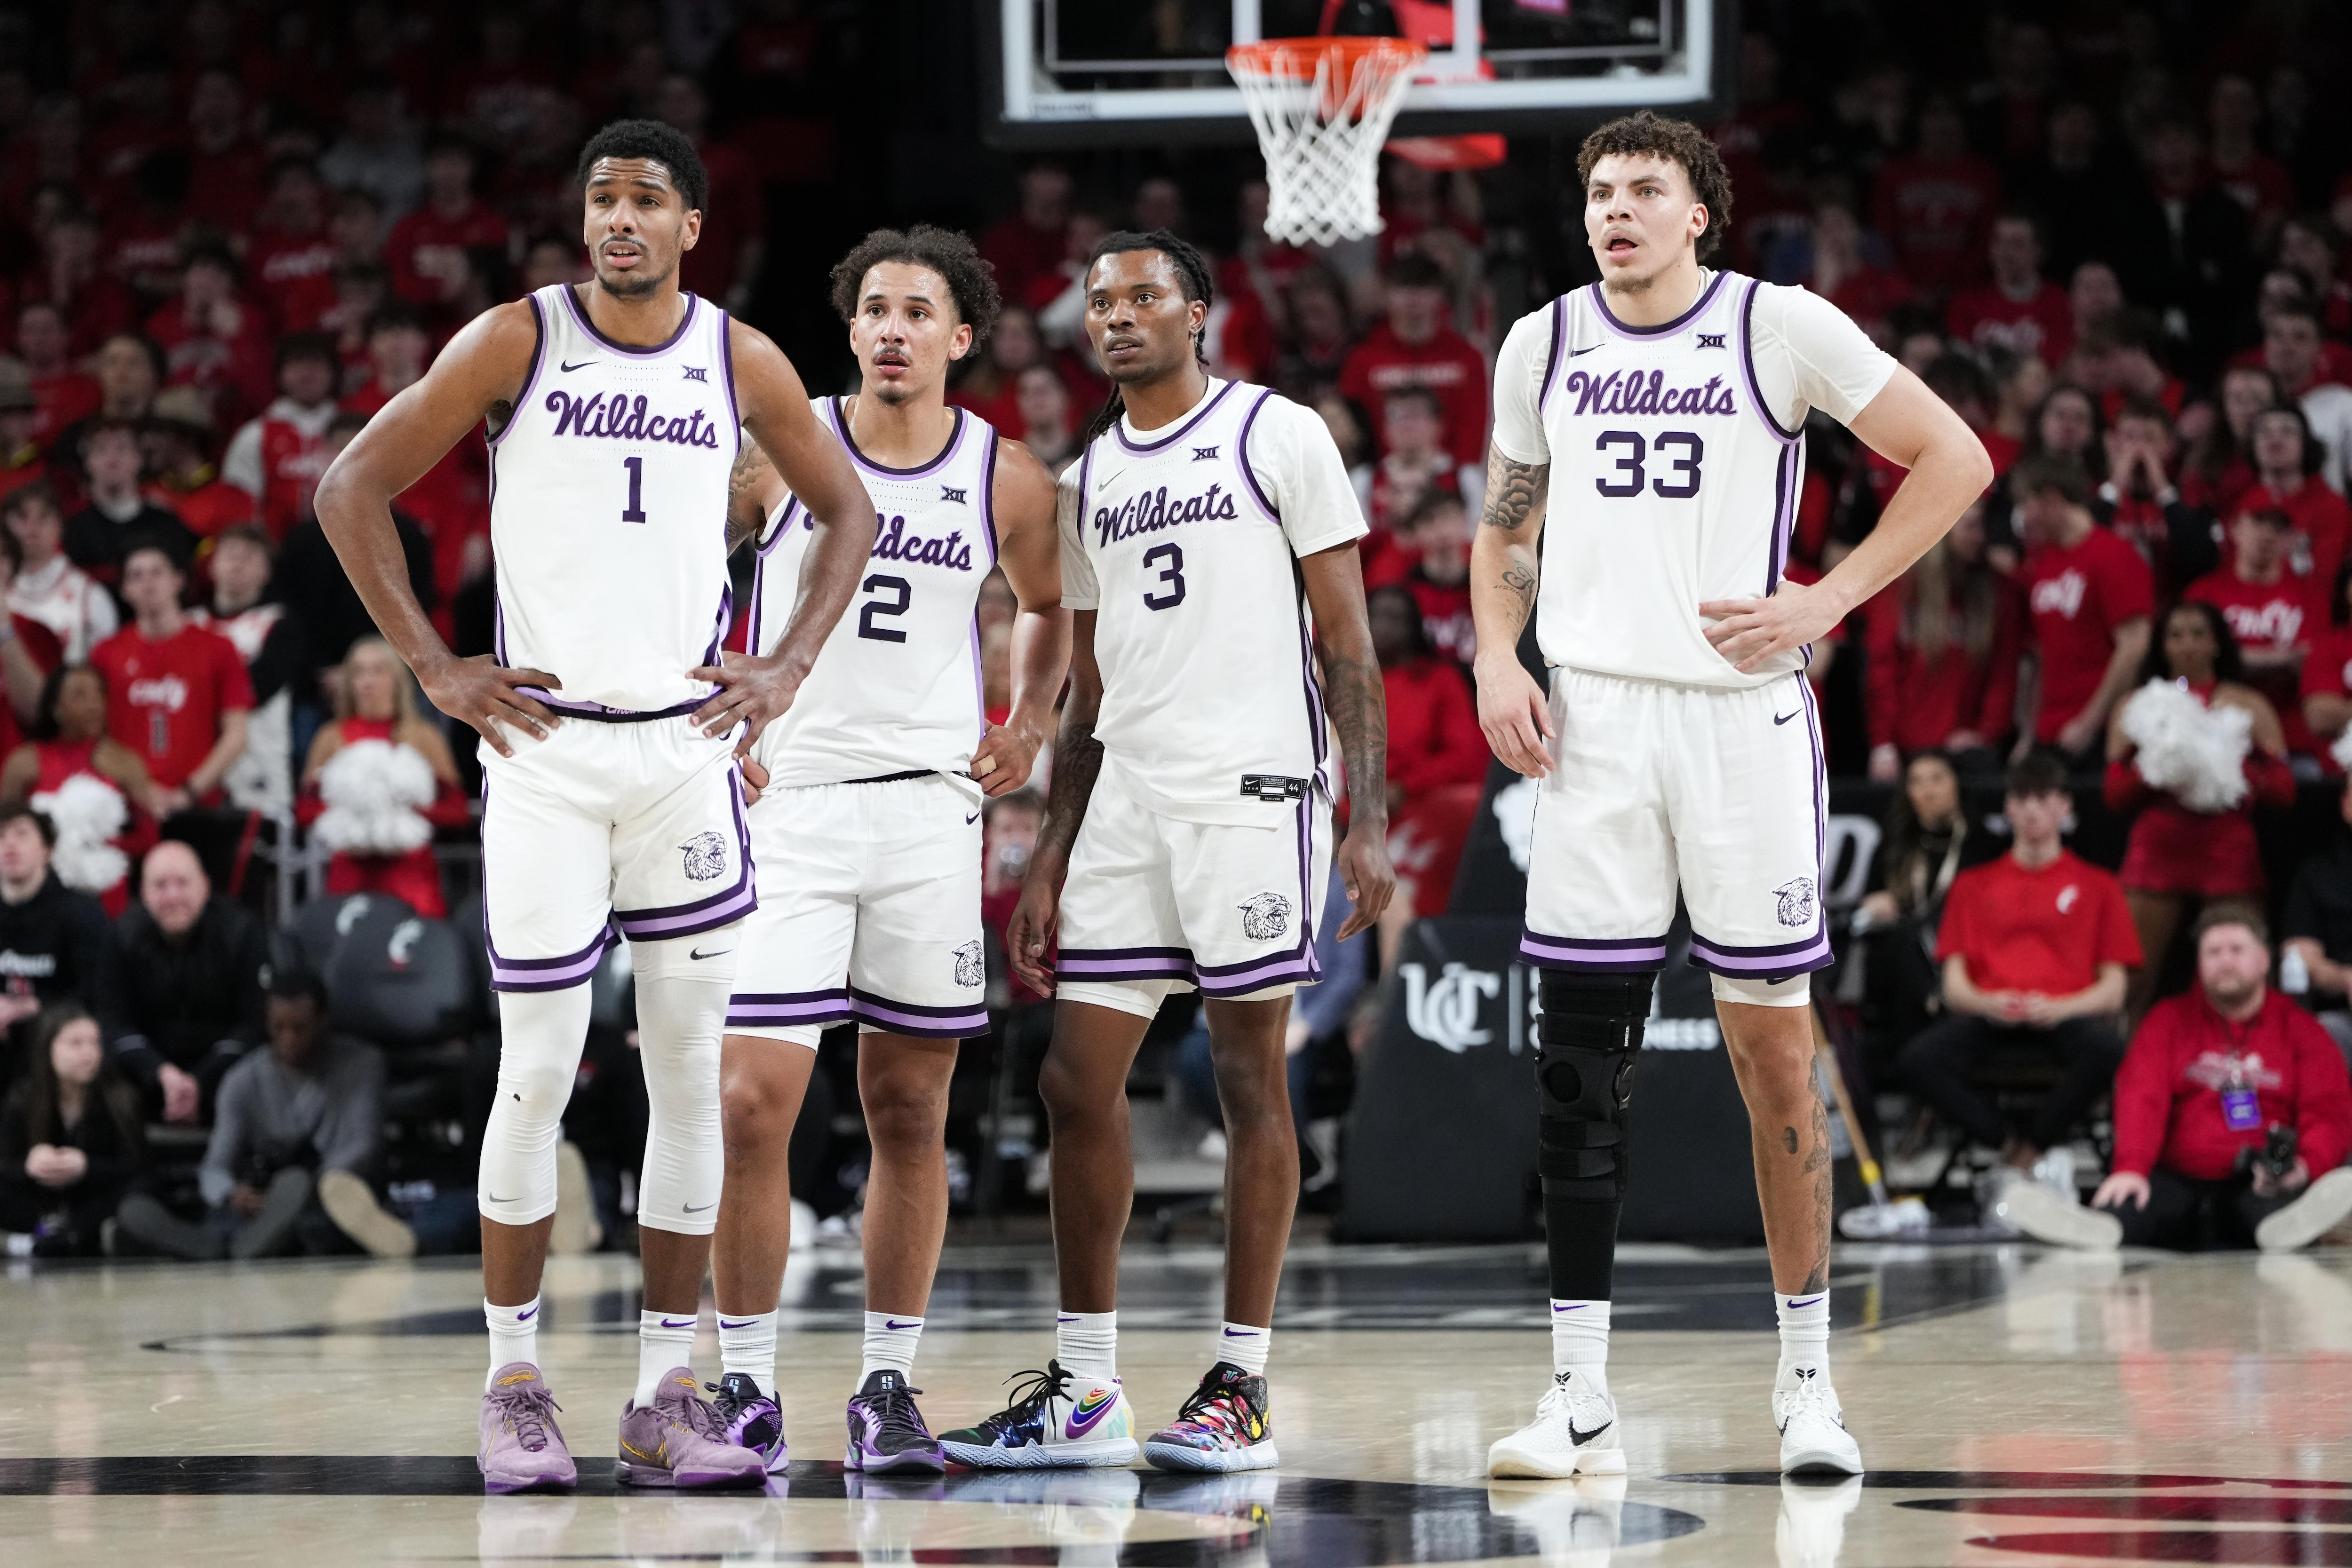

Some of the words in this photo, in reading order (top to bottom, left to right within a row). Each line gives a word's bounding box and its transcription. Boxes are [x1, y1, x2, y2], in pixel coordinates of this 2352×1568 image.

[545, 390, 719, 450] Wildcats
[1566, 369, 1738, 417] Wildcats
[622, 457, 646, 524] 1
[1596, 431, 1704, 498] 33
[1094, 480, 1239, 549] Wildcats
[858, 573, 912, 644] 2
[1143, 542, 1186, 611] 3
[1288, 783, 1299, 792] 44
[1398, 962, 1501, 1054] UC
